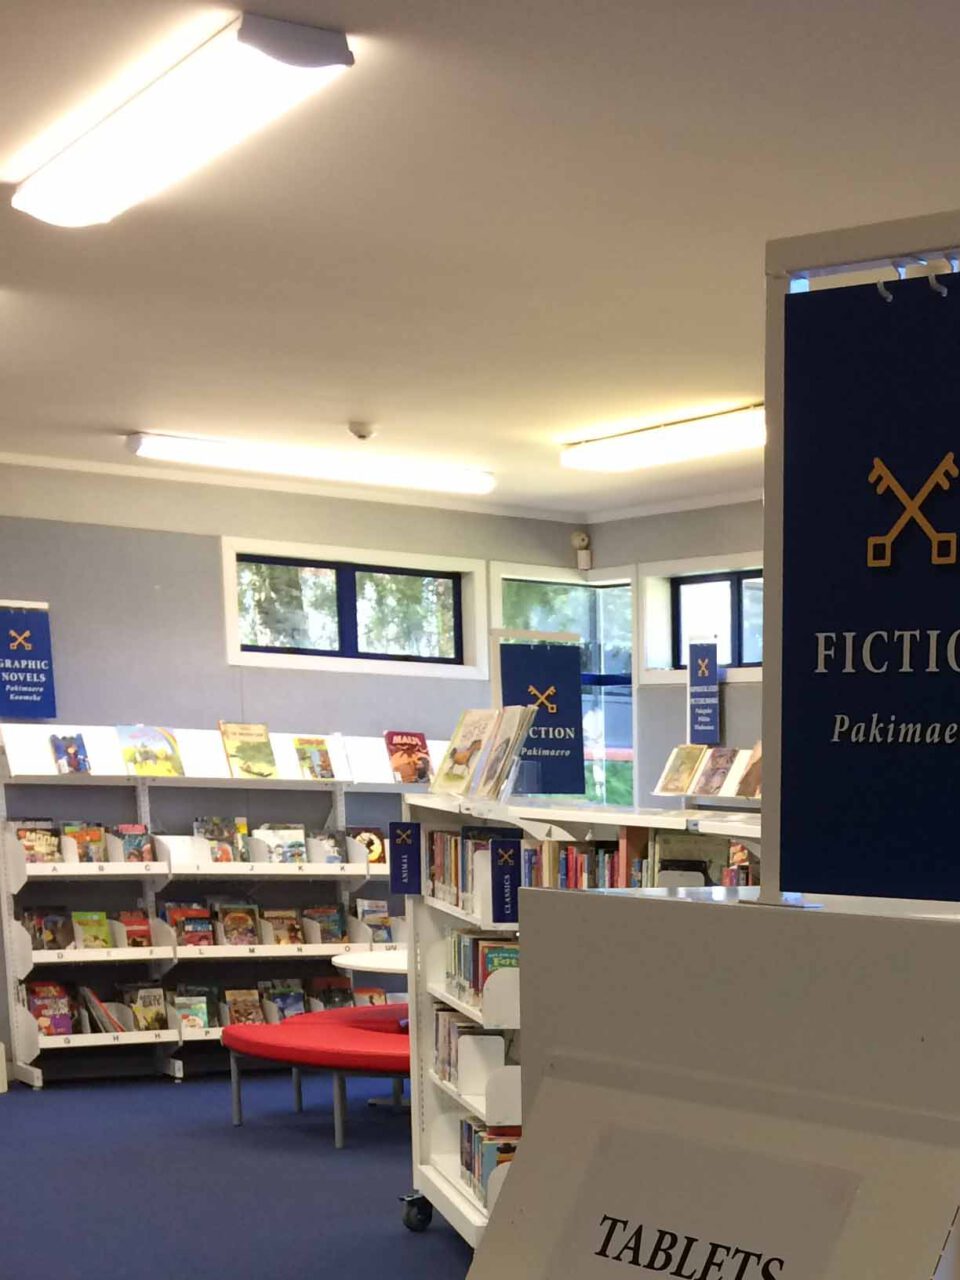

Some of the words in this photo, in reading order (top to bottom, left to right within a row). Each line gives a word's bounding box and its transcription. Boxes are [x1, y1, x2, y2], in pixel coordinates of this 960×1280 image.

[1, 671, 47, 682] NOVELS
[528, 726, 576, 740] CTION
[401, 853, 409, 883] ANIMAL
[504, 873, 512, 915] CLASSICS
